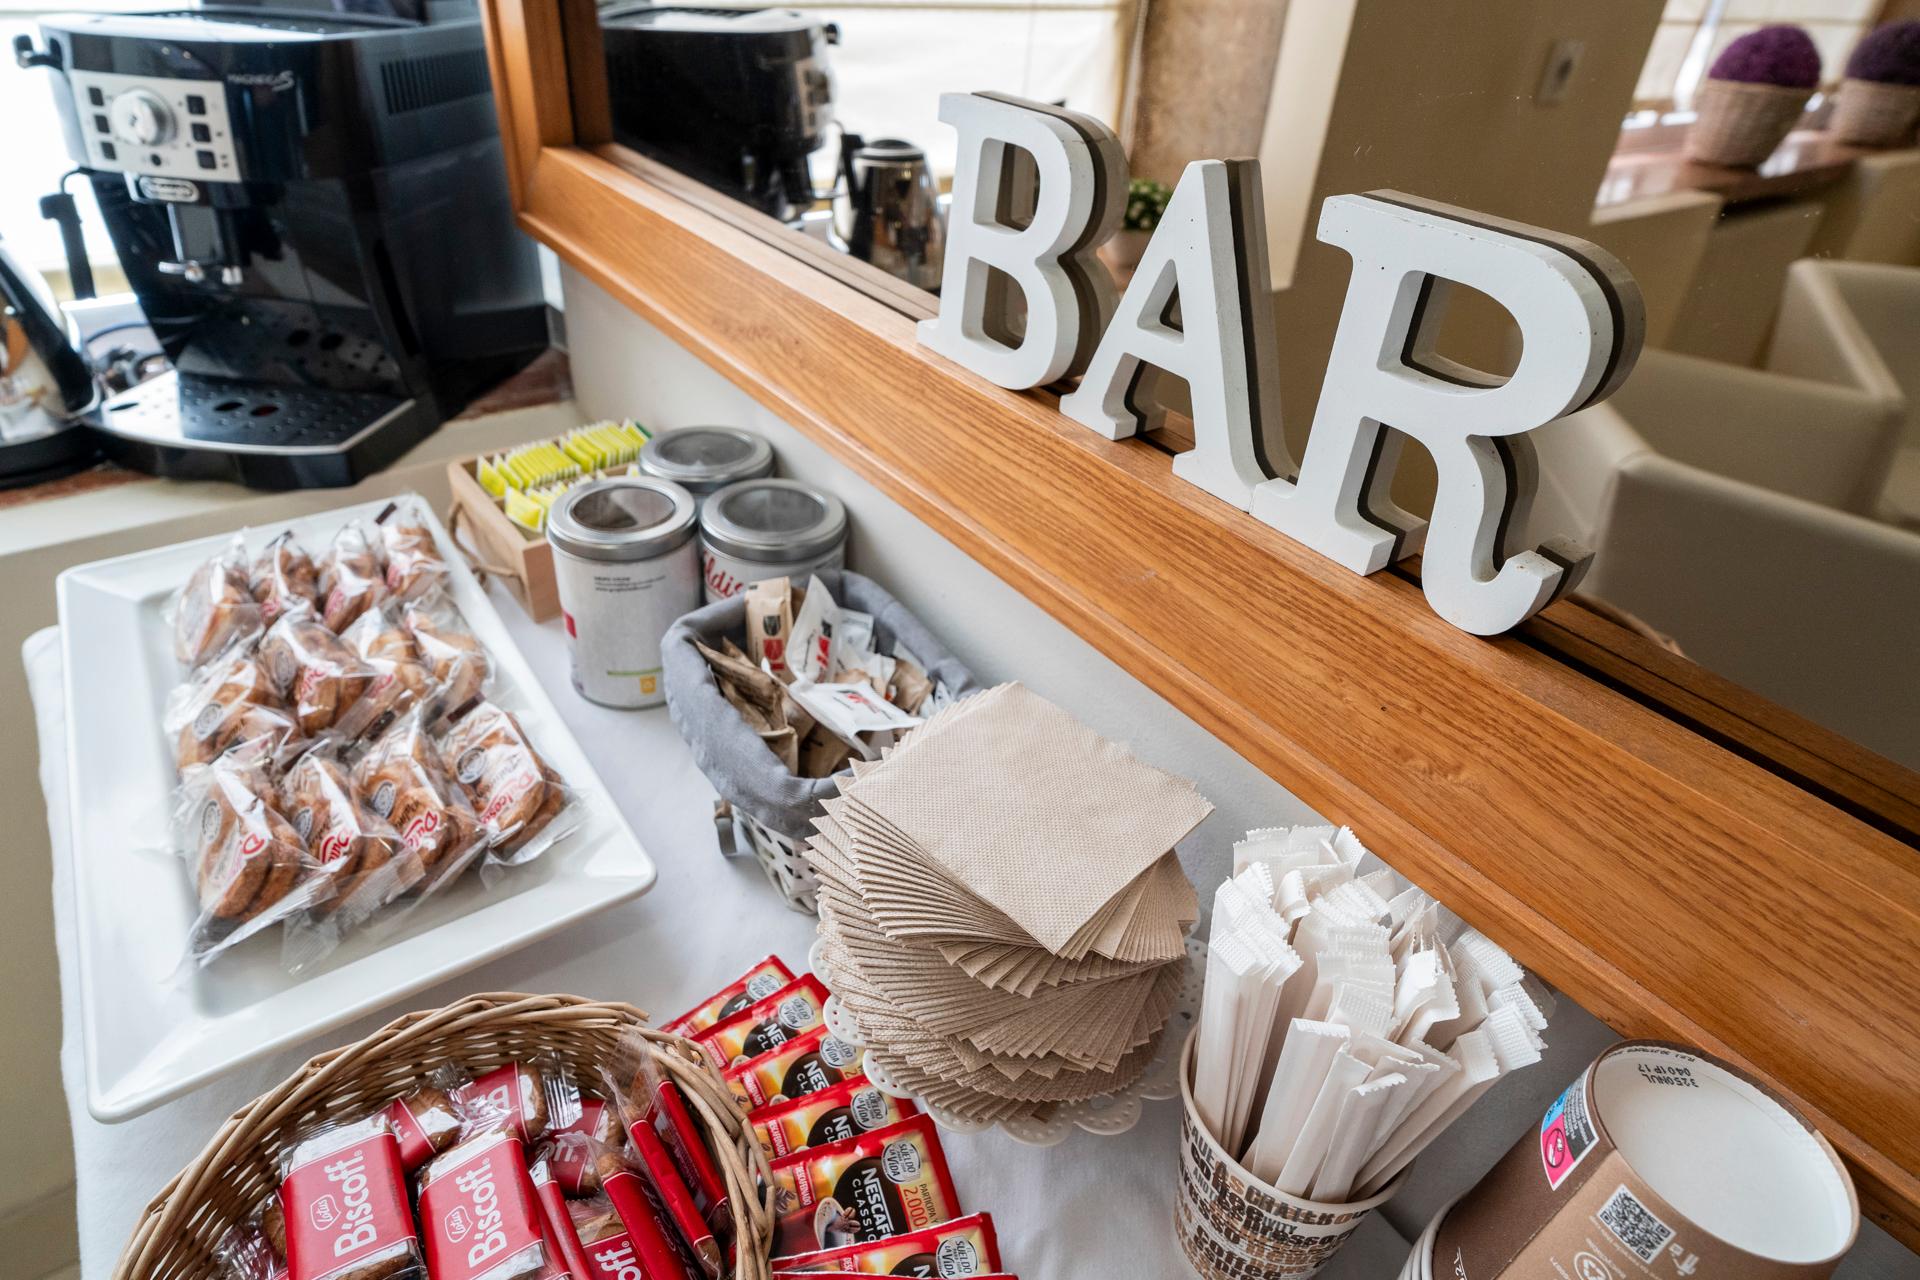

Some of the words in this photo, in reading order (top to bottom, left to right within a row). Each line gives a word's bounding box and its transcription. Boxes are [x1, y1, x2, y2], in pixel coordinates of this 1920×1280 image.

[917, 92, 1612, 636] BAR
[825, 1045, 840, 1063] VIDA
[856, 1103, 870, 1123] VIDA
[866, 1091, 883, 1120] SUELDO
[887, 1156, 901, 1177] VIDA
[899, 1143, 916, 1173] SUELDO
[324, 1155, 378, 1258] Biscoff
[919, 1183, 936, 1216] PARTICIPA
[455, 1162, 508, 1269] Biscoff
[942, 1254, 956, 1276] VIDA
[944, 1245, 952, 1256] LA
[956, 1240, 973, 1274] SUELDO
